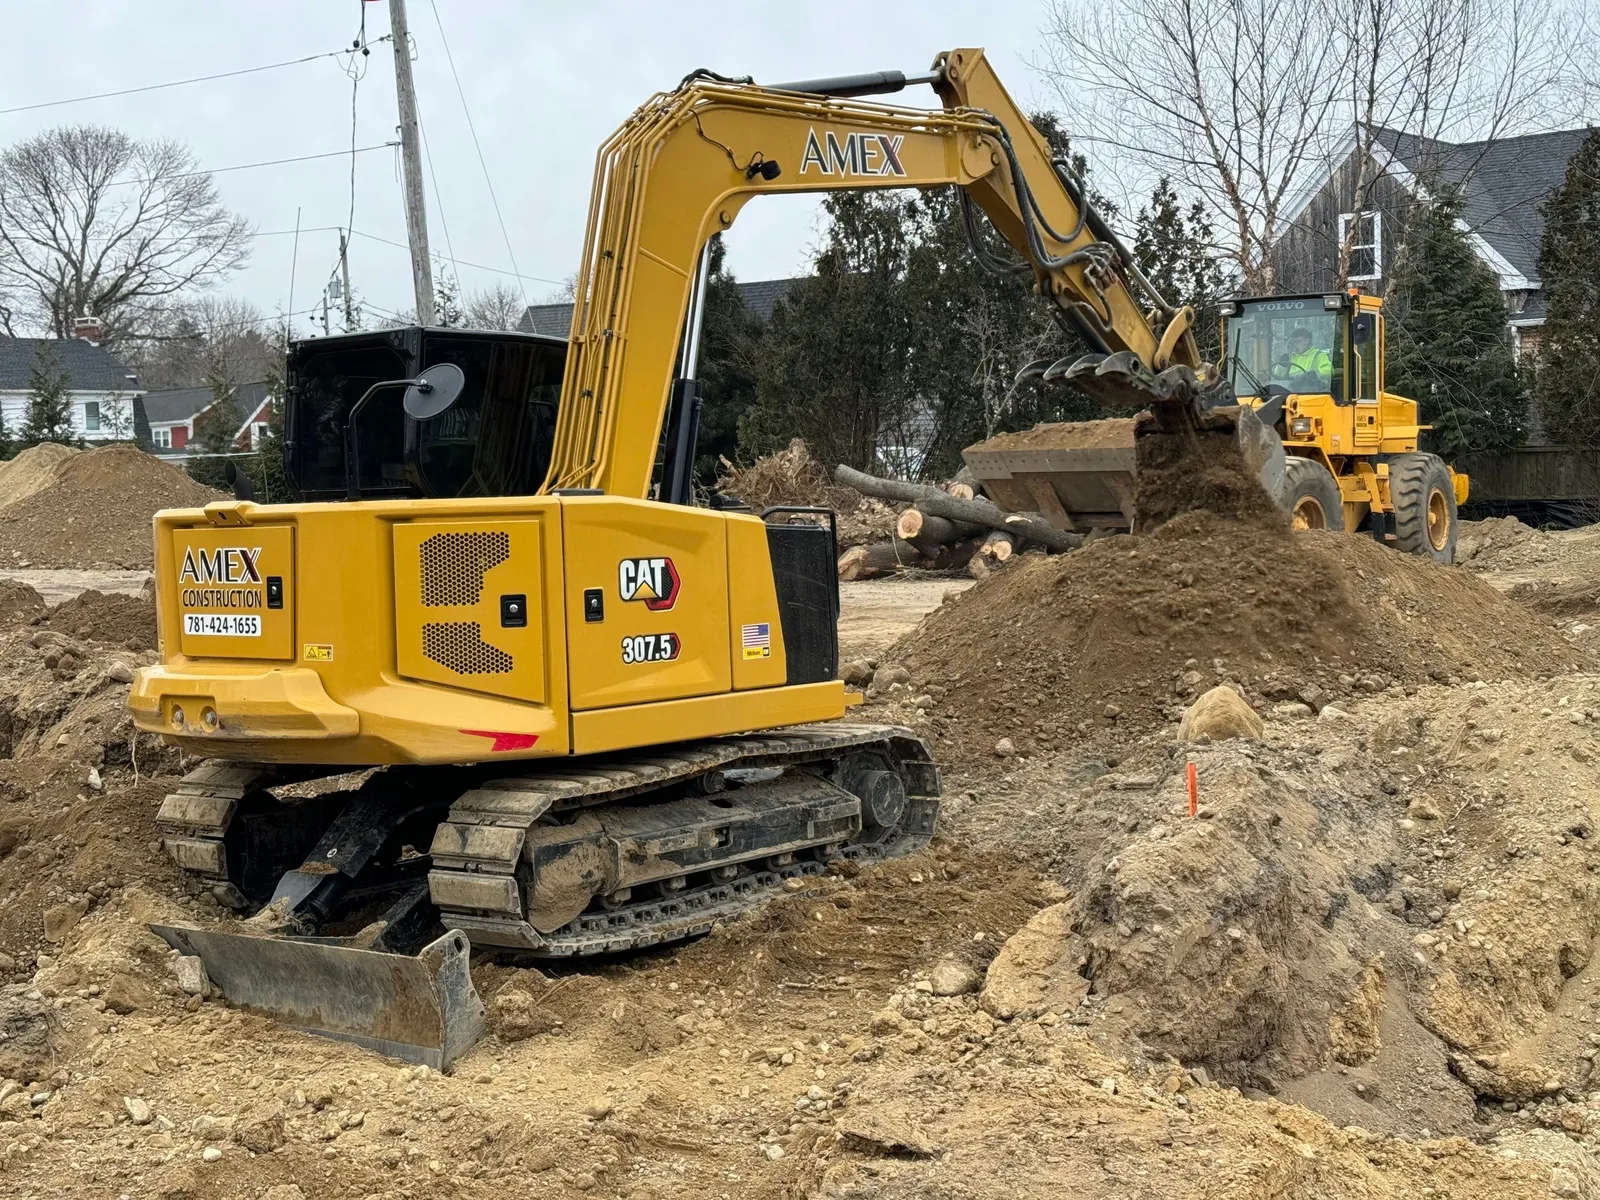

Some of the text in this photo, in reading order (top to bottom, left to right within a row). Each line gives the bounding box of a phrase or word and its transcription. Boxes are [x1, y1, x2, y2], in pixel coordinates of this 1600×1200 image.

[799, 125, 907, 179] AMEX
[1256, 301, 1305, 312] VOLVO
[179, 545, 263, 586] AMEX
[619, 558, 666, 601] CAT
[182, 588, 262, 608] CONSTRUCTION
[187, 616, 257, 634] 781-424-1655
[621, 635, 672, 664] 307.5
